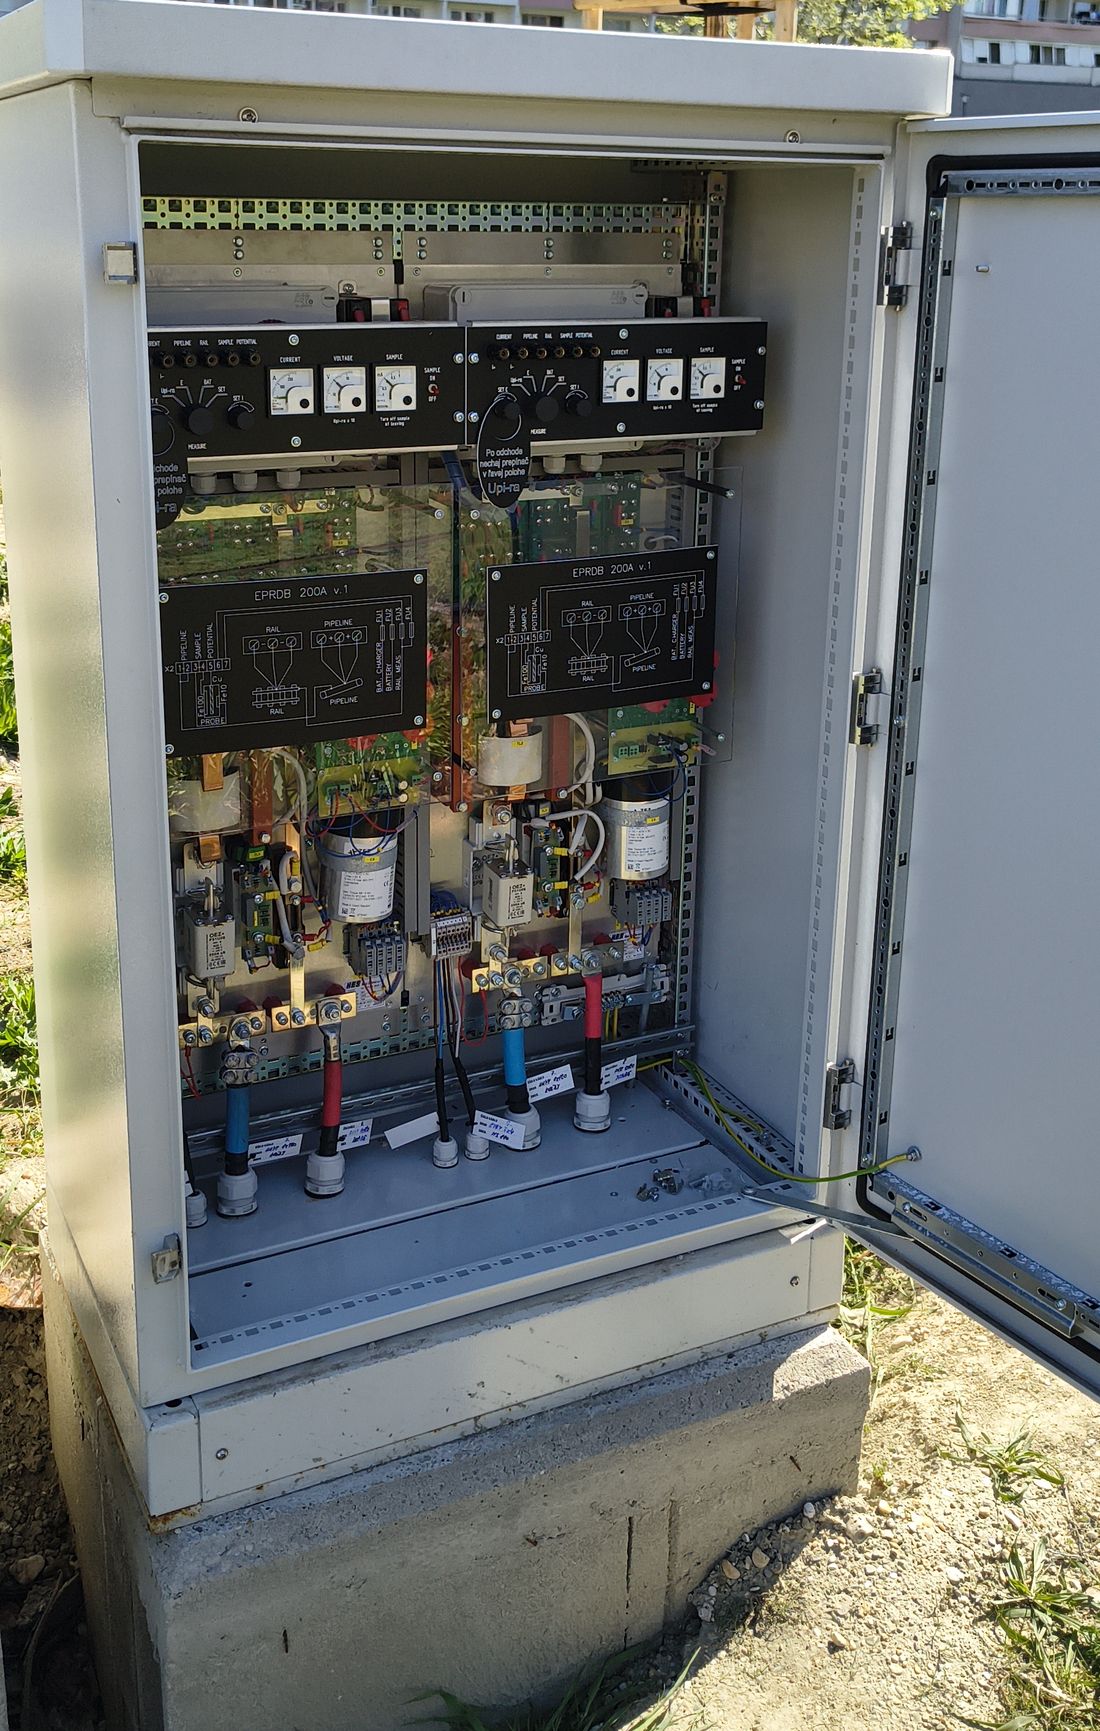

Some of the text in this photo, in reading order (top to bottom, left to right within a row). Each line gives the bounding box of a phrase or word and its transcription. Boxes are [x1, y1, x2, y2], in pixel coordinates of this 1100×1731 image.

[486, 447, 523, 457] Po odchode
[480, 458, 501, 468] nechaj
[504, 468, 526, 479] polohe
[157, 486, 183, 497] polohe
[488, 482, 520, 496] Upi-ra
[572, 561, 652, 578] EPRDB 200A v.1
[254, 584, 349, 601] EPRDB 200A v.1
[629, 592, 655, 601] PIPELINE
[375, 609, 383, 623] FU1
[323, 618, 353, 628] PIPELINE
[180, 630, 188, 661] PIPELINE
[194, 632, 202, 660] SAMPLE
[206, 622, 215, 659] POTENTIAL
[375, 642, 383, 675] CHARGER
[165, 665, 174, 673] X2
[394, 655, 402, 674] MEAS
[632, 663, 656, 672] PIPELINE
[212, 675, 223, 683] Cu
[220, 684, 228, 702] Fe10
[523, 684, 545, 692] PROBE
[197, 695, 205, 718] Fe100
[329, 696, 359, 706] PIPELINE
[200, 717, 225, 725] PROBE
